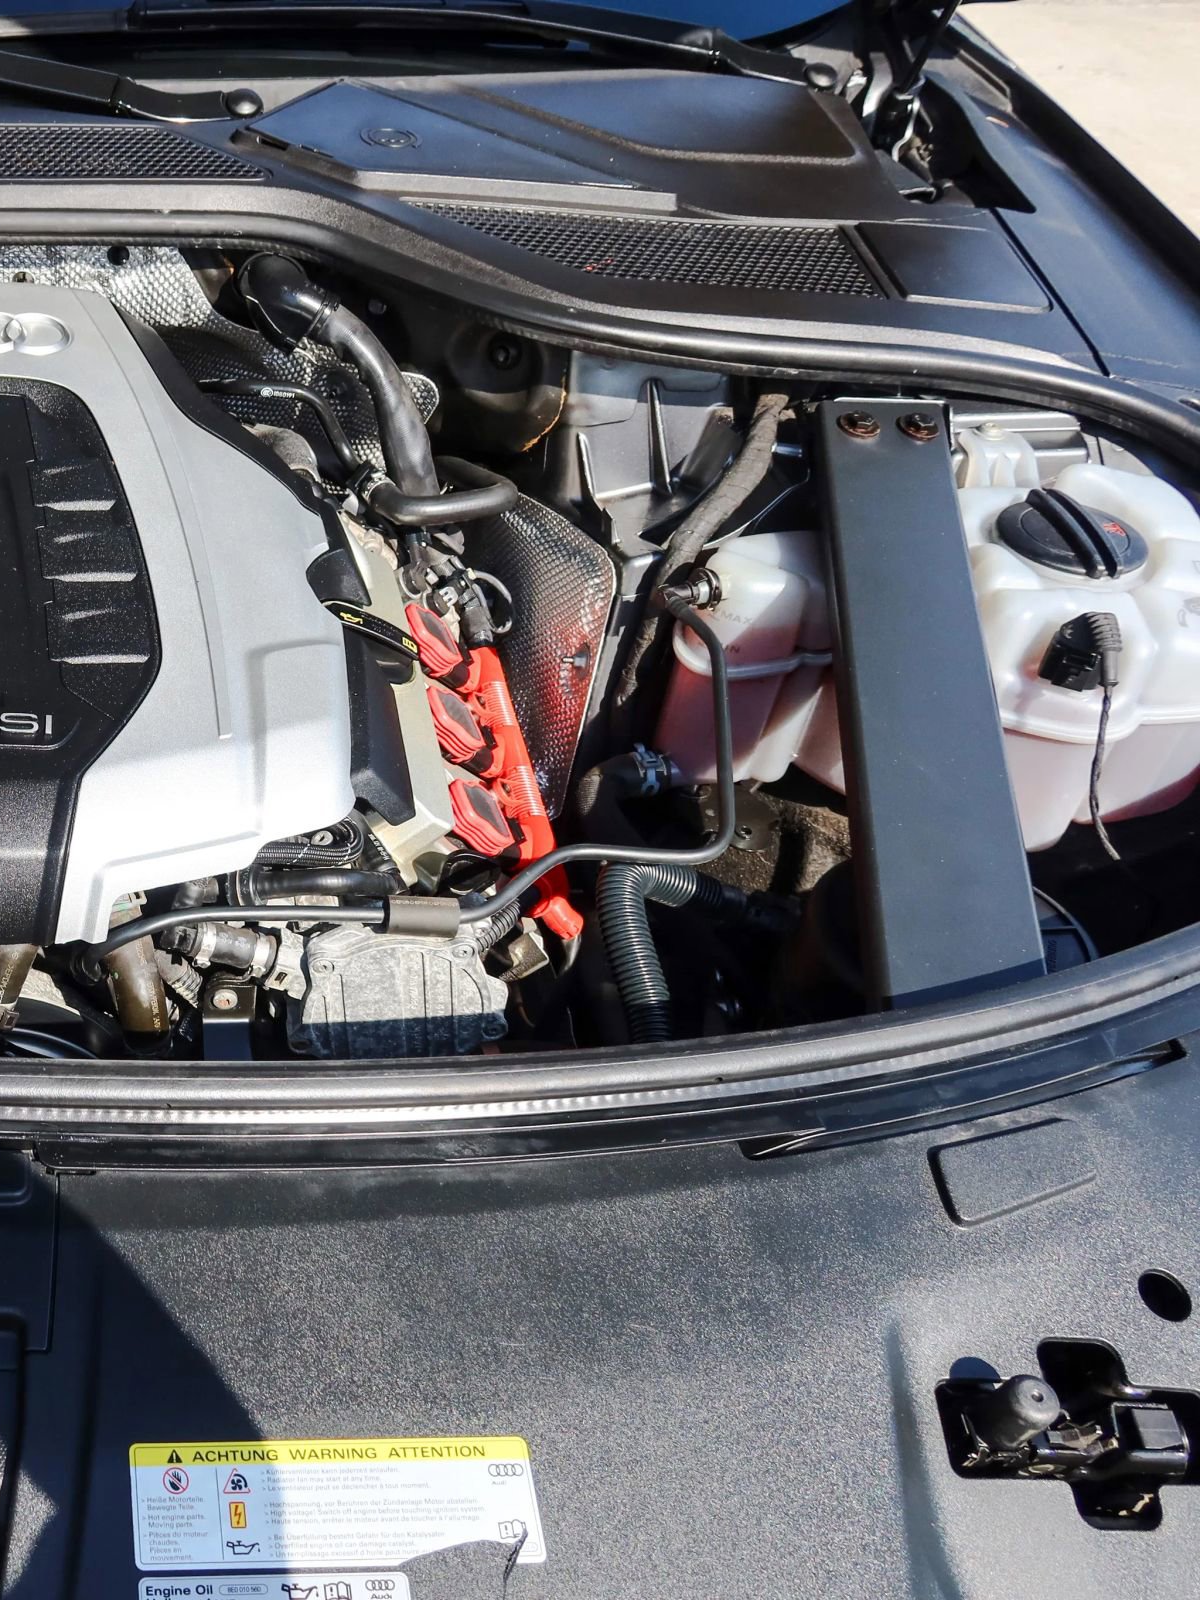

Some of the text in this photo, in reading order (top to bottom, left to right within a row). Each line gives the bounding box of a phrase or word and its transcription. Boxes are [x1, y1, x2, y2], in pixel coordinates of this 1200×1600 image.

[721, 610, 752, 624] MAX
[192, 1446, 486, 1463] ACHTUNG WARNING ATTENTION
[146, 1584, 213, 1598] Engine Oil
